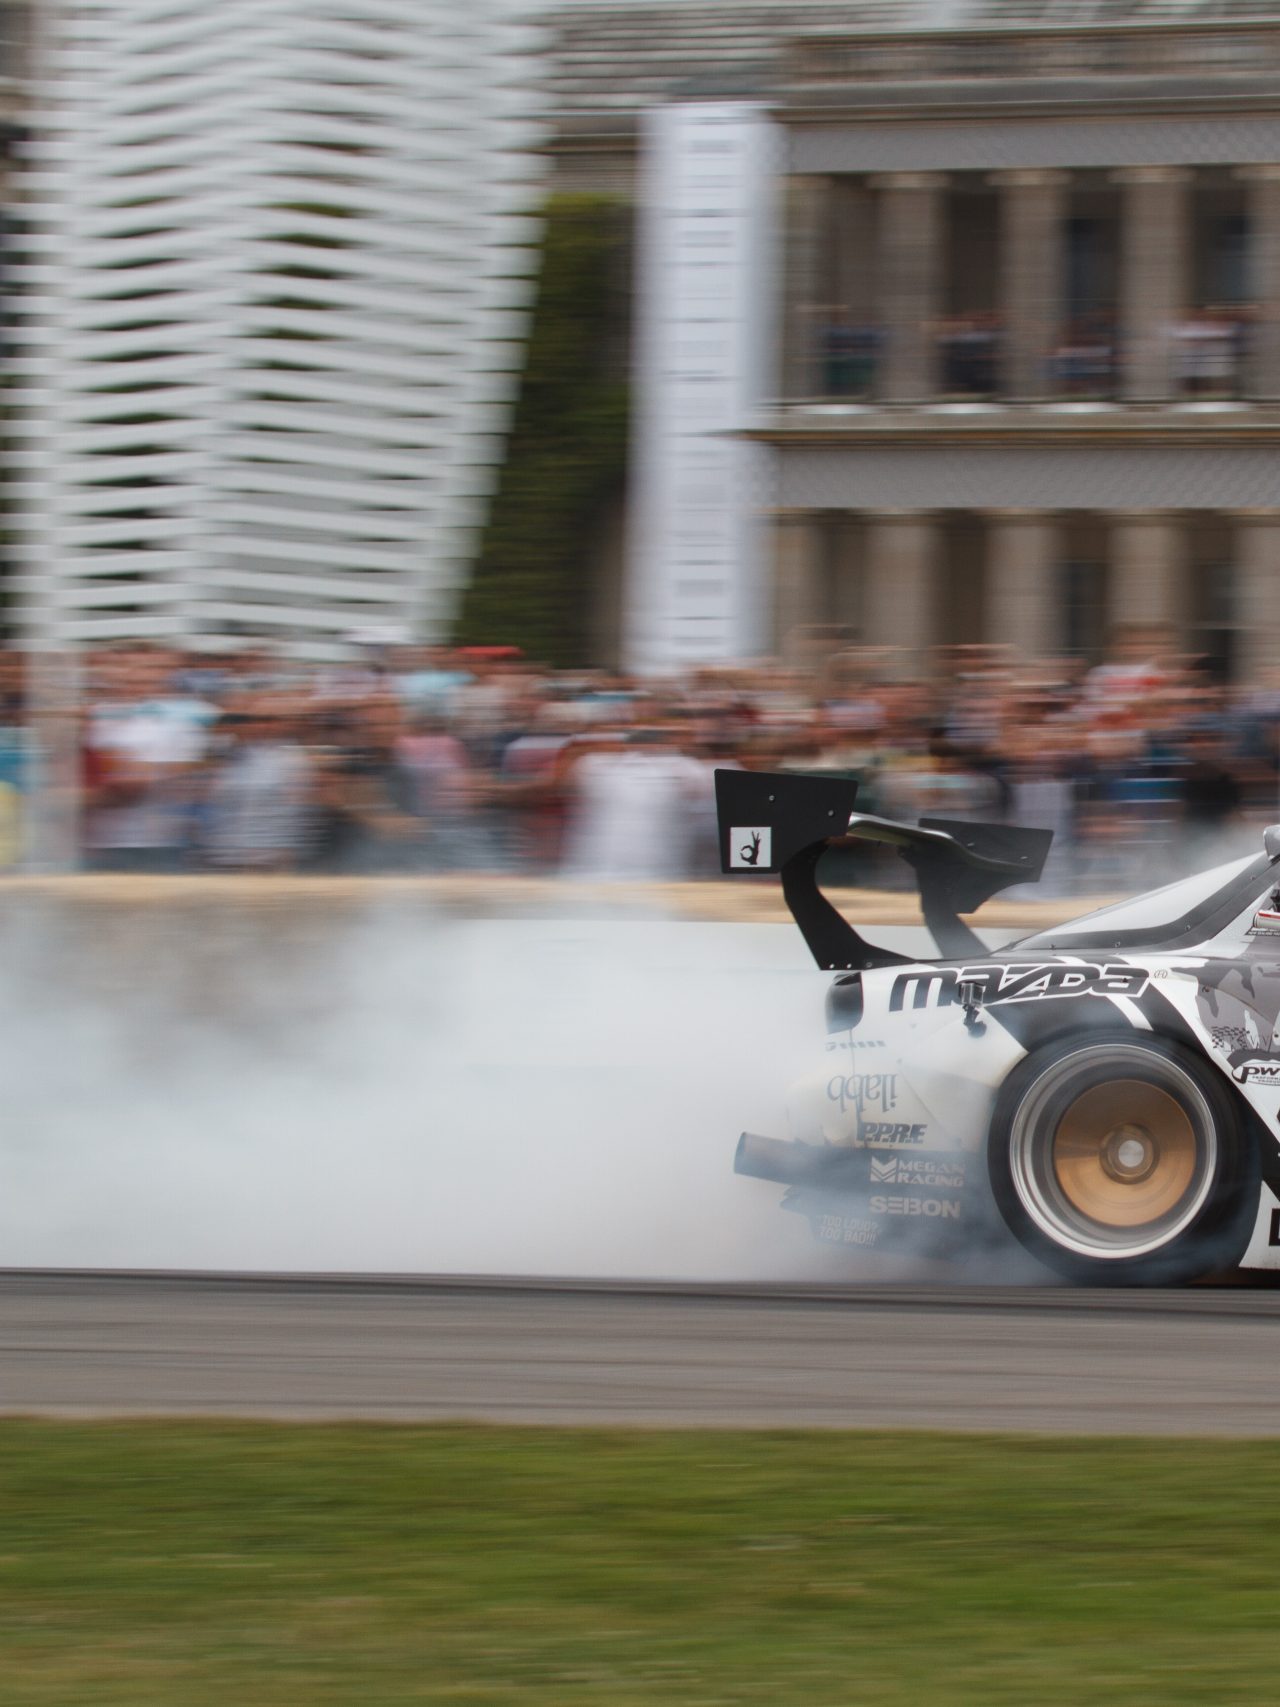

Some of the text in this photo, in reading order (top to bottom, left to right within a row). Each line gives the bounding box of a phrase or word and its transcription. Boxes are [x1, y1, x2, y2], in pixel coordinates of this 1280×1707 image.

[898, 1159, 965, 1174] MEGAN
[897, 1172, 964, 1187] RACING
[869, 1196, 961, 1218] SEIBON
